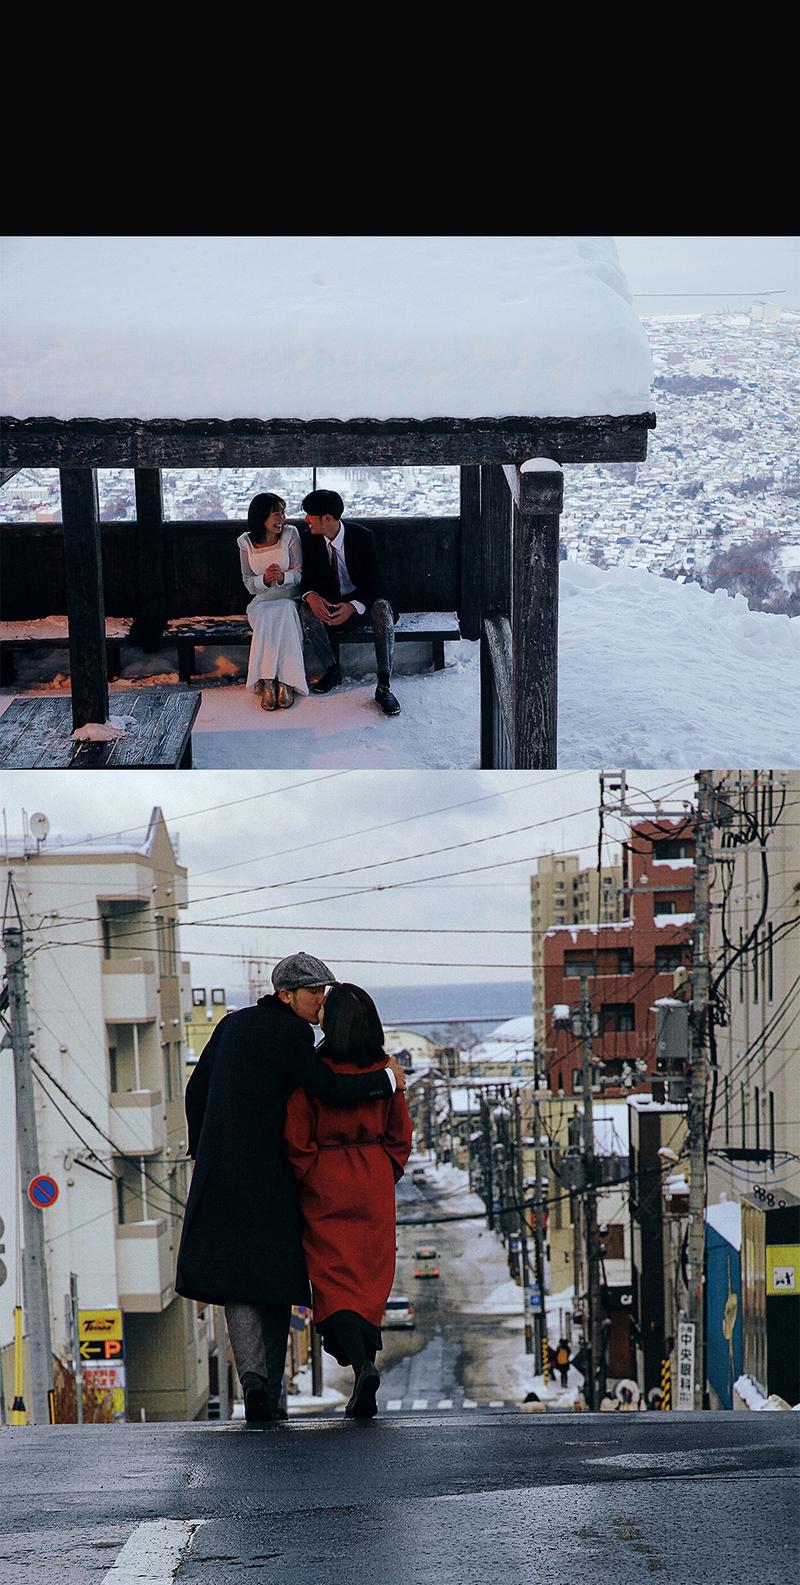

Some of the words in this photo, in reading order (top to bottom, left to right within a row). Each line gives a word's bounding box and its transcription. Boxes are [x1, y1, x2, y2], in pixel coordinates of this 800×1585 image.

[104, 1340, 121, 1359] P
[680, 1333, 692, 1391] 中央眼科
